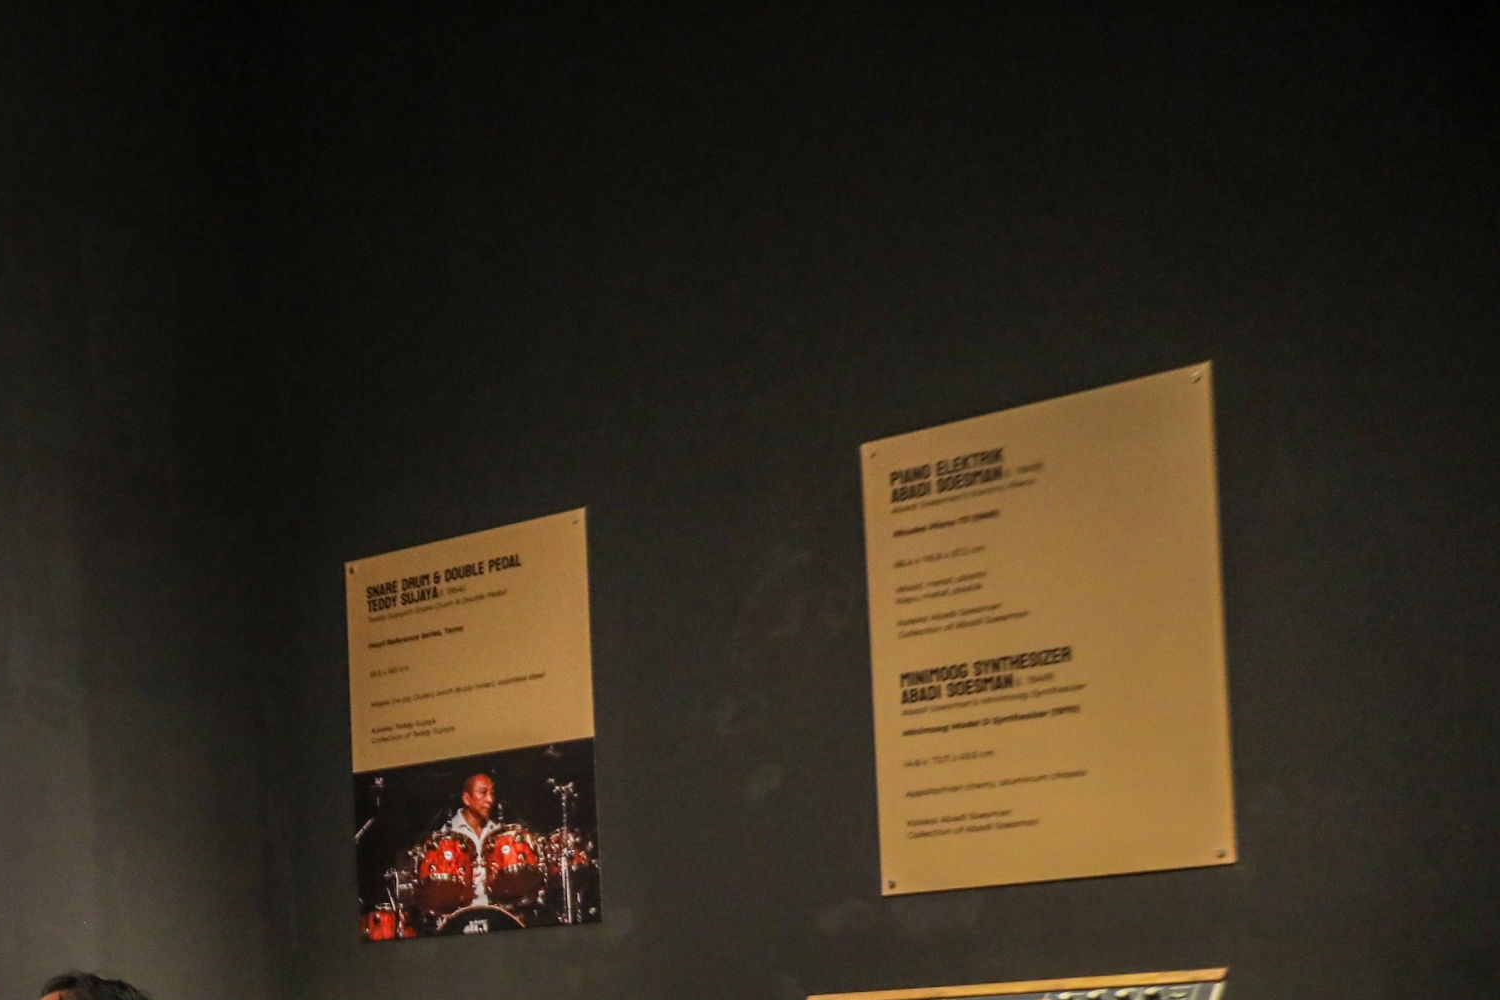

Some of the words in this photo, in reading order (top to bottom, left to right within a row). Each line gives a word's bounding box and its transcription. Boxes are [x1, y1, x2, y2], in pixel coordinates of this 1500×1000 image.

[890, 463, 931, 486] PIANO
[936, 447, 1004, 476] ELEKTRIK
[891, 481, 932, 503] ABADI
[936, 465, 1003, 493] SOESMAN
[366, 580, 398, 599] SNARE
[402, 574, 431, 591] DRUM
[433, 571, 441, 584] &
[444, 561, 484, 582] DOUBLE
[488, 554, 522, 572] PEDAL
[367, 595, 398, 613] TEDDY
[401, 586, 439, 606] SUJAYA
[900, 663, 968, 687] MINIMOOG
[973, 646, 1072, 676] SYNTHESIZER
[901, 685, 942, 704] ABADI
[946, 674, 1014, 697] SOESMAN
